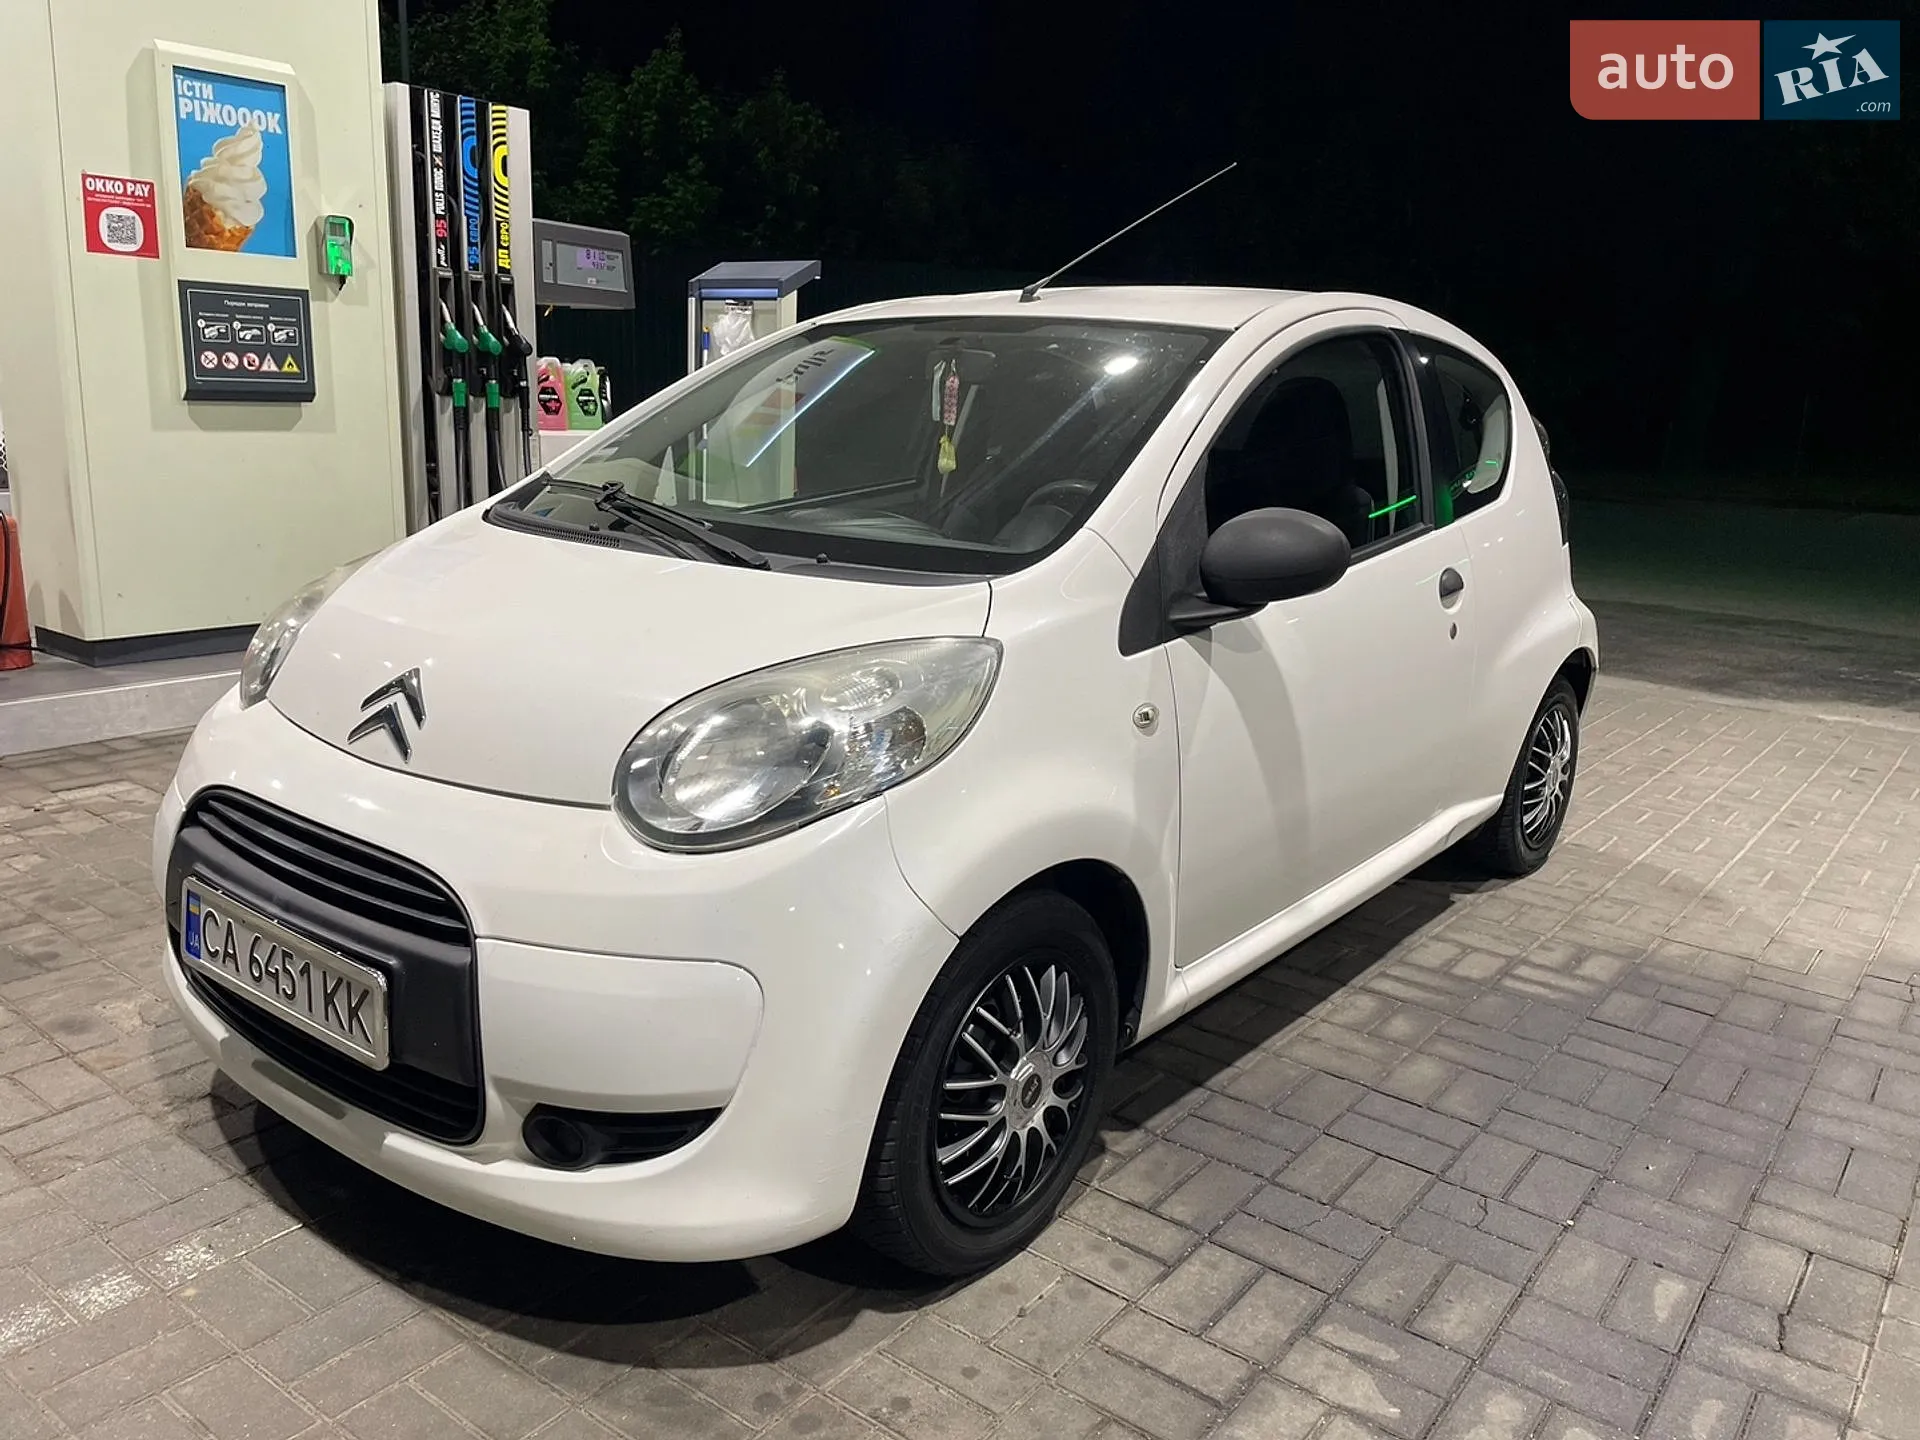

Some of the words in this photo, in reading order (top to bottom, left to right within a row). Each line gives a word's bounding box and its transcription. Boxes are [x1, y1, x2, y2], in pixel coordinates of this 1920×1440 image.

[175, 75, 213, 99] ЇСТИ
[178, 97, 283, 134] РІЖОООК
[85, 177, 124, 194] OKKO
[126, 182, 150, 197] PAY
[435, 219, 447, 238] 95
[498, 248, 511, 269] ДП
[203, 908, 240, 973] CA
[249, 934, 313, 1013] 6451
[322, 970, 374, 1045] KK
